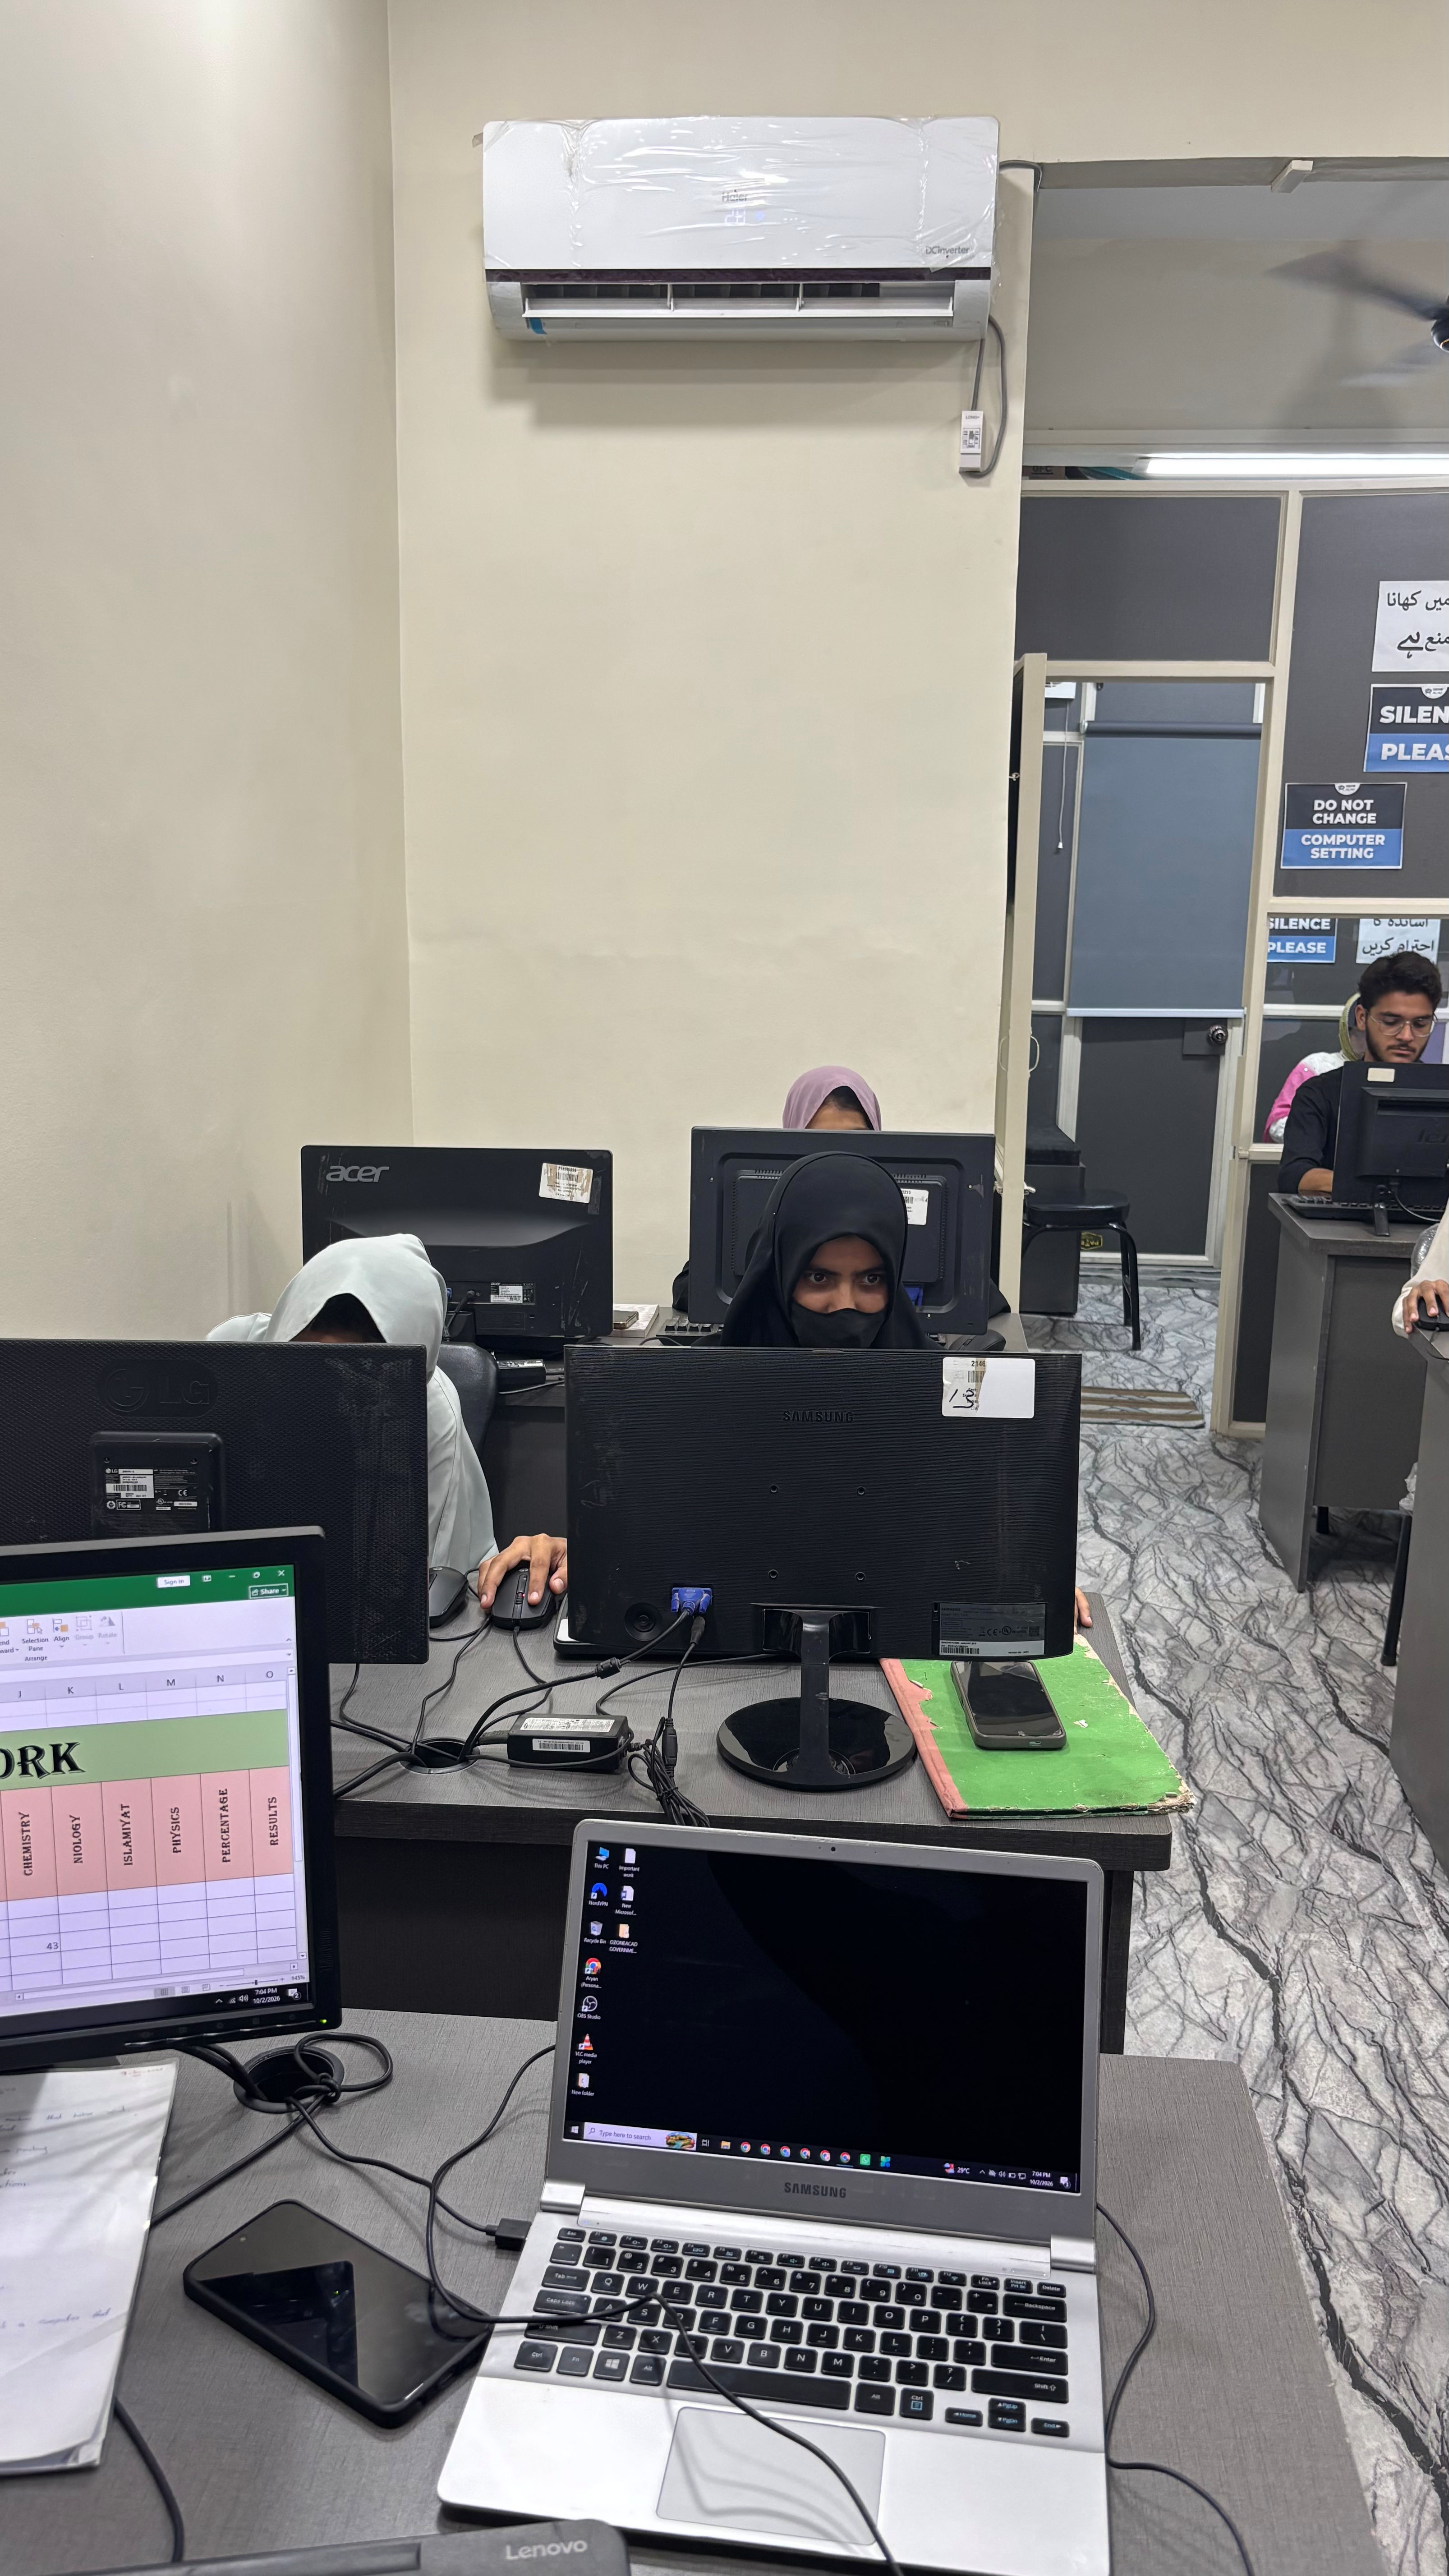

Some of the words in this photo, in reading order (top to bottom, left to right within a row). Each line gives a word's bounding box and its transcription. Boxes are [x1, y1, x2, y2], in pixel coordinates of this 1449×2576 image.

[1387, 590, 1422, 611] کھانا
[1313, 799, 1337, 811] DO
[1341, 799, 1374, 811] NOT
[1312, 813, 1377, 824] CHANGE
[1301, 834, 1385, 846] COMPUTER
[1310, 847, 1374, 859] SETTING
[1267, 942, 1327, 954] PLEASE
[326, 1165, 390, 1183] acer
[782, 1410, 854, 1422] SAMSUNG
[218, 1788, 231, 1863] PERCENTAGE
[267, 1796, 279, 1846] RESULTS
[69, 1814, 83, 1864] NIOLOGY
[120, 1803, 133, 1866] ISLAMIYAT
[170, 1807, 182, 1854] PHYSICS
[18, 1811, 33, 1876] CHEMISTRY
[599, 2130, 612, 2138] Type
[784, 2182, 847, 2199] SAMSUNG
[604, 2277, 612, 2286] Q
[797, 2354, 805, 2362] N
[506, 2539, 588, 2561] Lenovo
